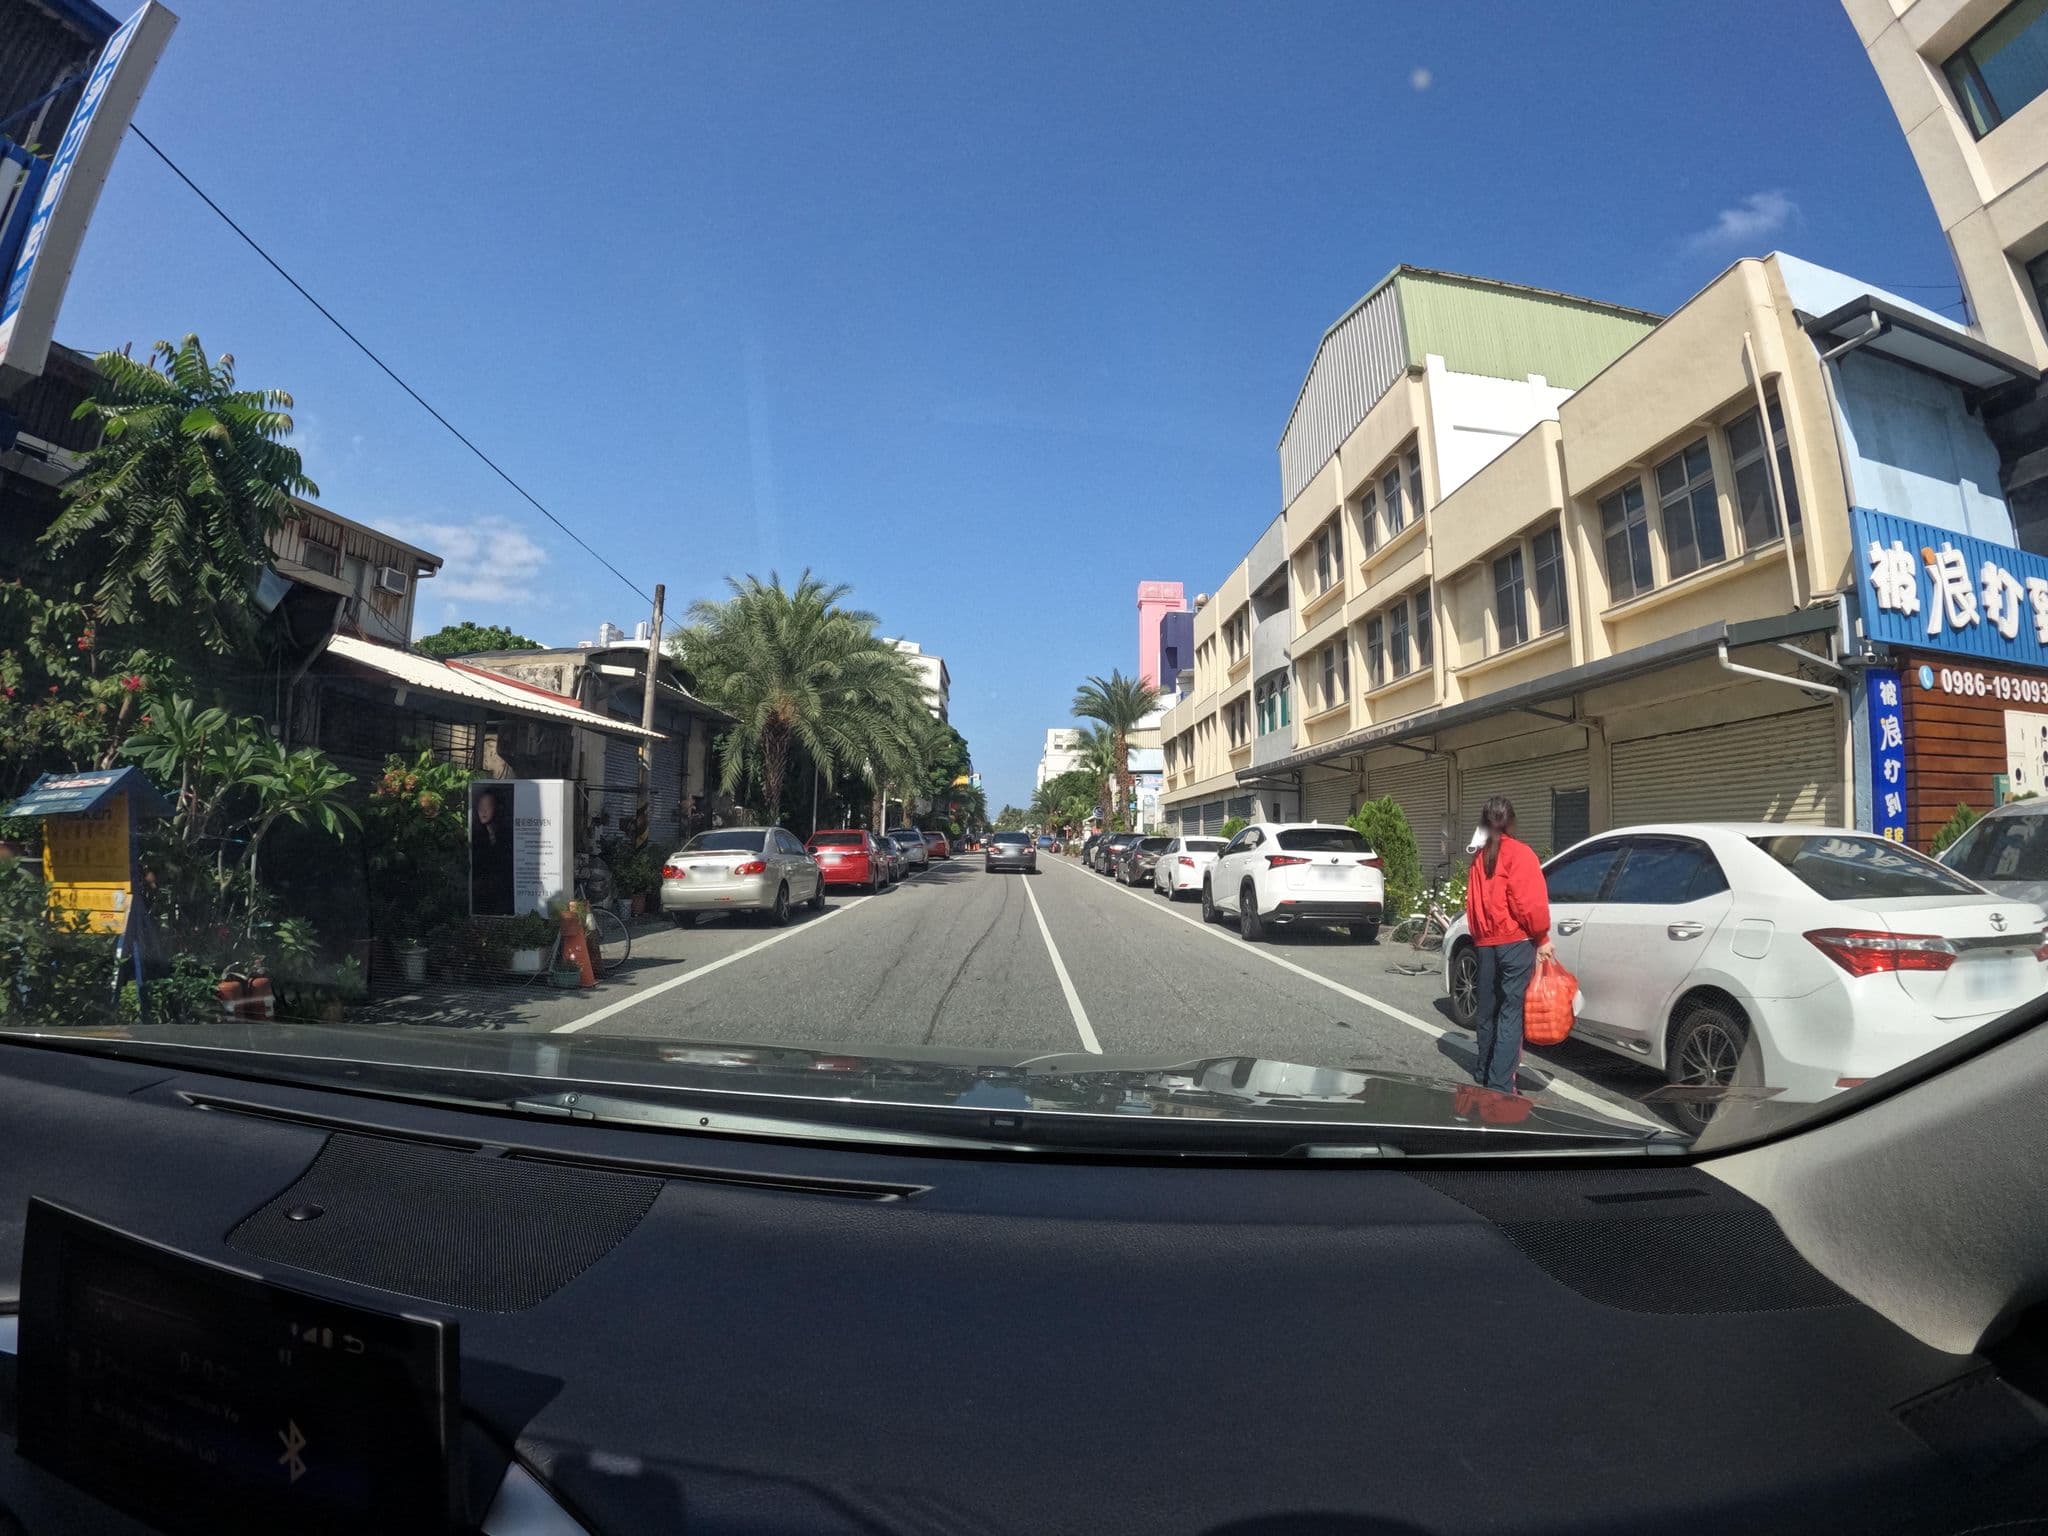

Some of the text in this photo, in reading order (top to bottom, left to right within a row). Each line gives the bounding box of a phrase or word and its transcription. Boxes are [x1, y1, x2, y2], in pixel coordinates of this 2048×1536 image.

[1940, 668, 2048, 704] 0986-193093
[1879, 679, 1903, 818] 被浪打到
